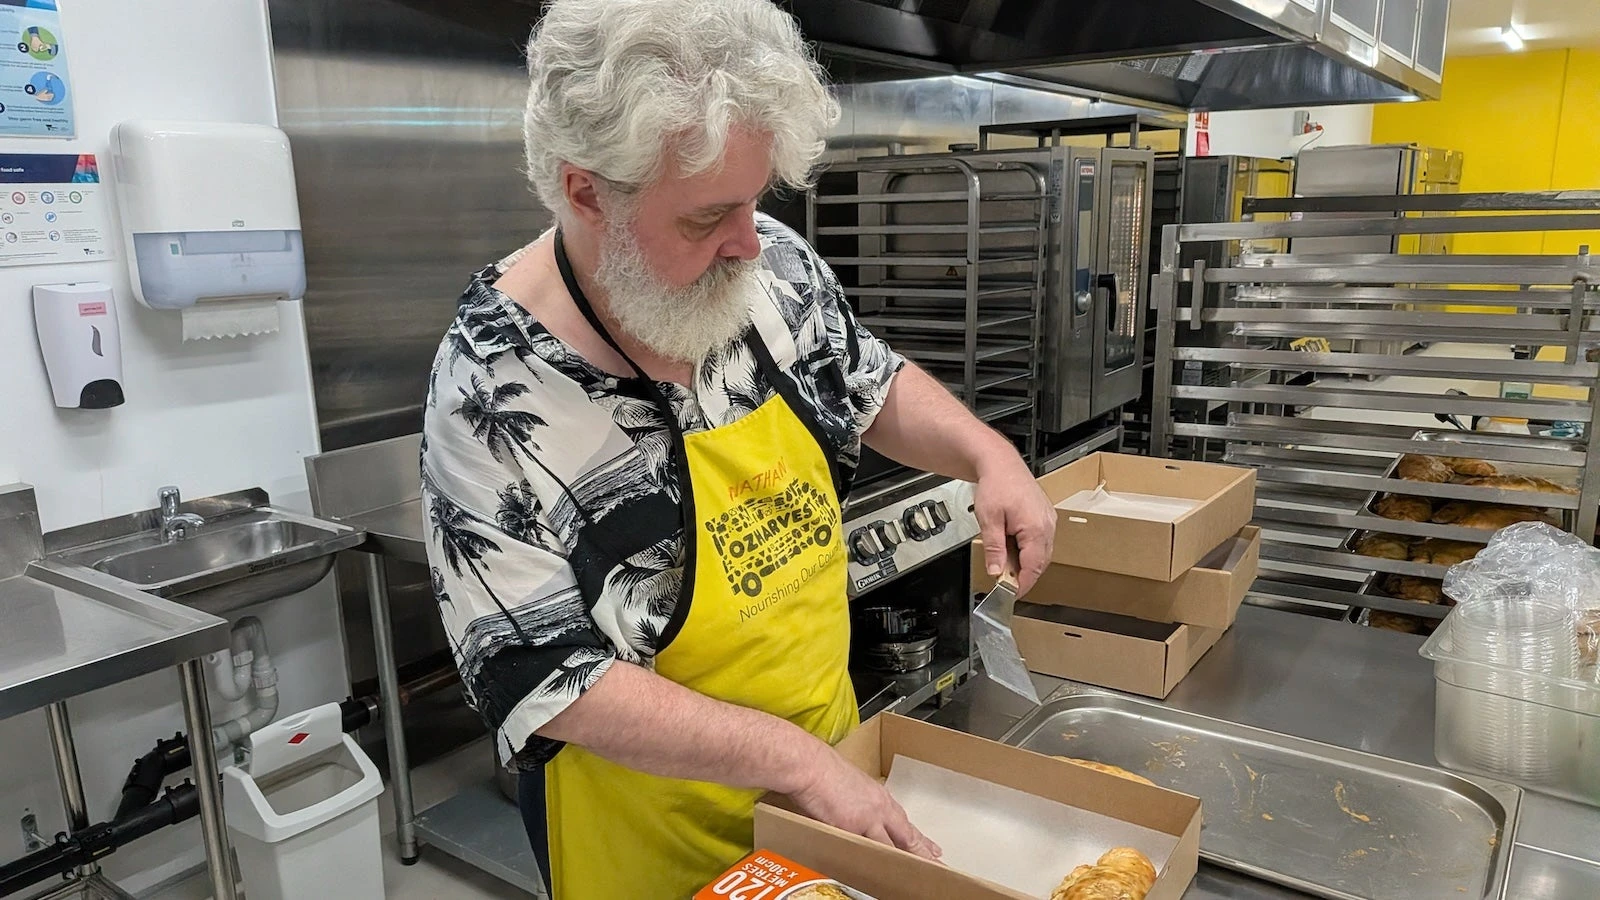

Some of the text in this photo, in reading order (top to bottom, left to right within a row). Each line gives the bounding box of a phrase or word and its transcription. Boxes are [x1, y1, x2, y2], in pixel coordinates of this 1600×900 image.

[727, 456, 787, 502] NATHAN
[729, 497, 818, 558] OZHARVEST
[739, 580, 800, 622] Nourishing
[801, 564, 817, 583] Our
[857, 572, 882, 589] GIORIK
[741, 863, 789, 887] METRES
[754, 856, 799, 879] x 30cm
[712, 870, 775, 900] 120
